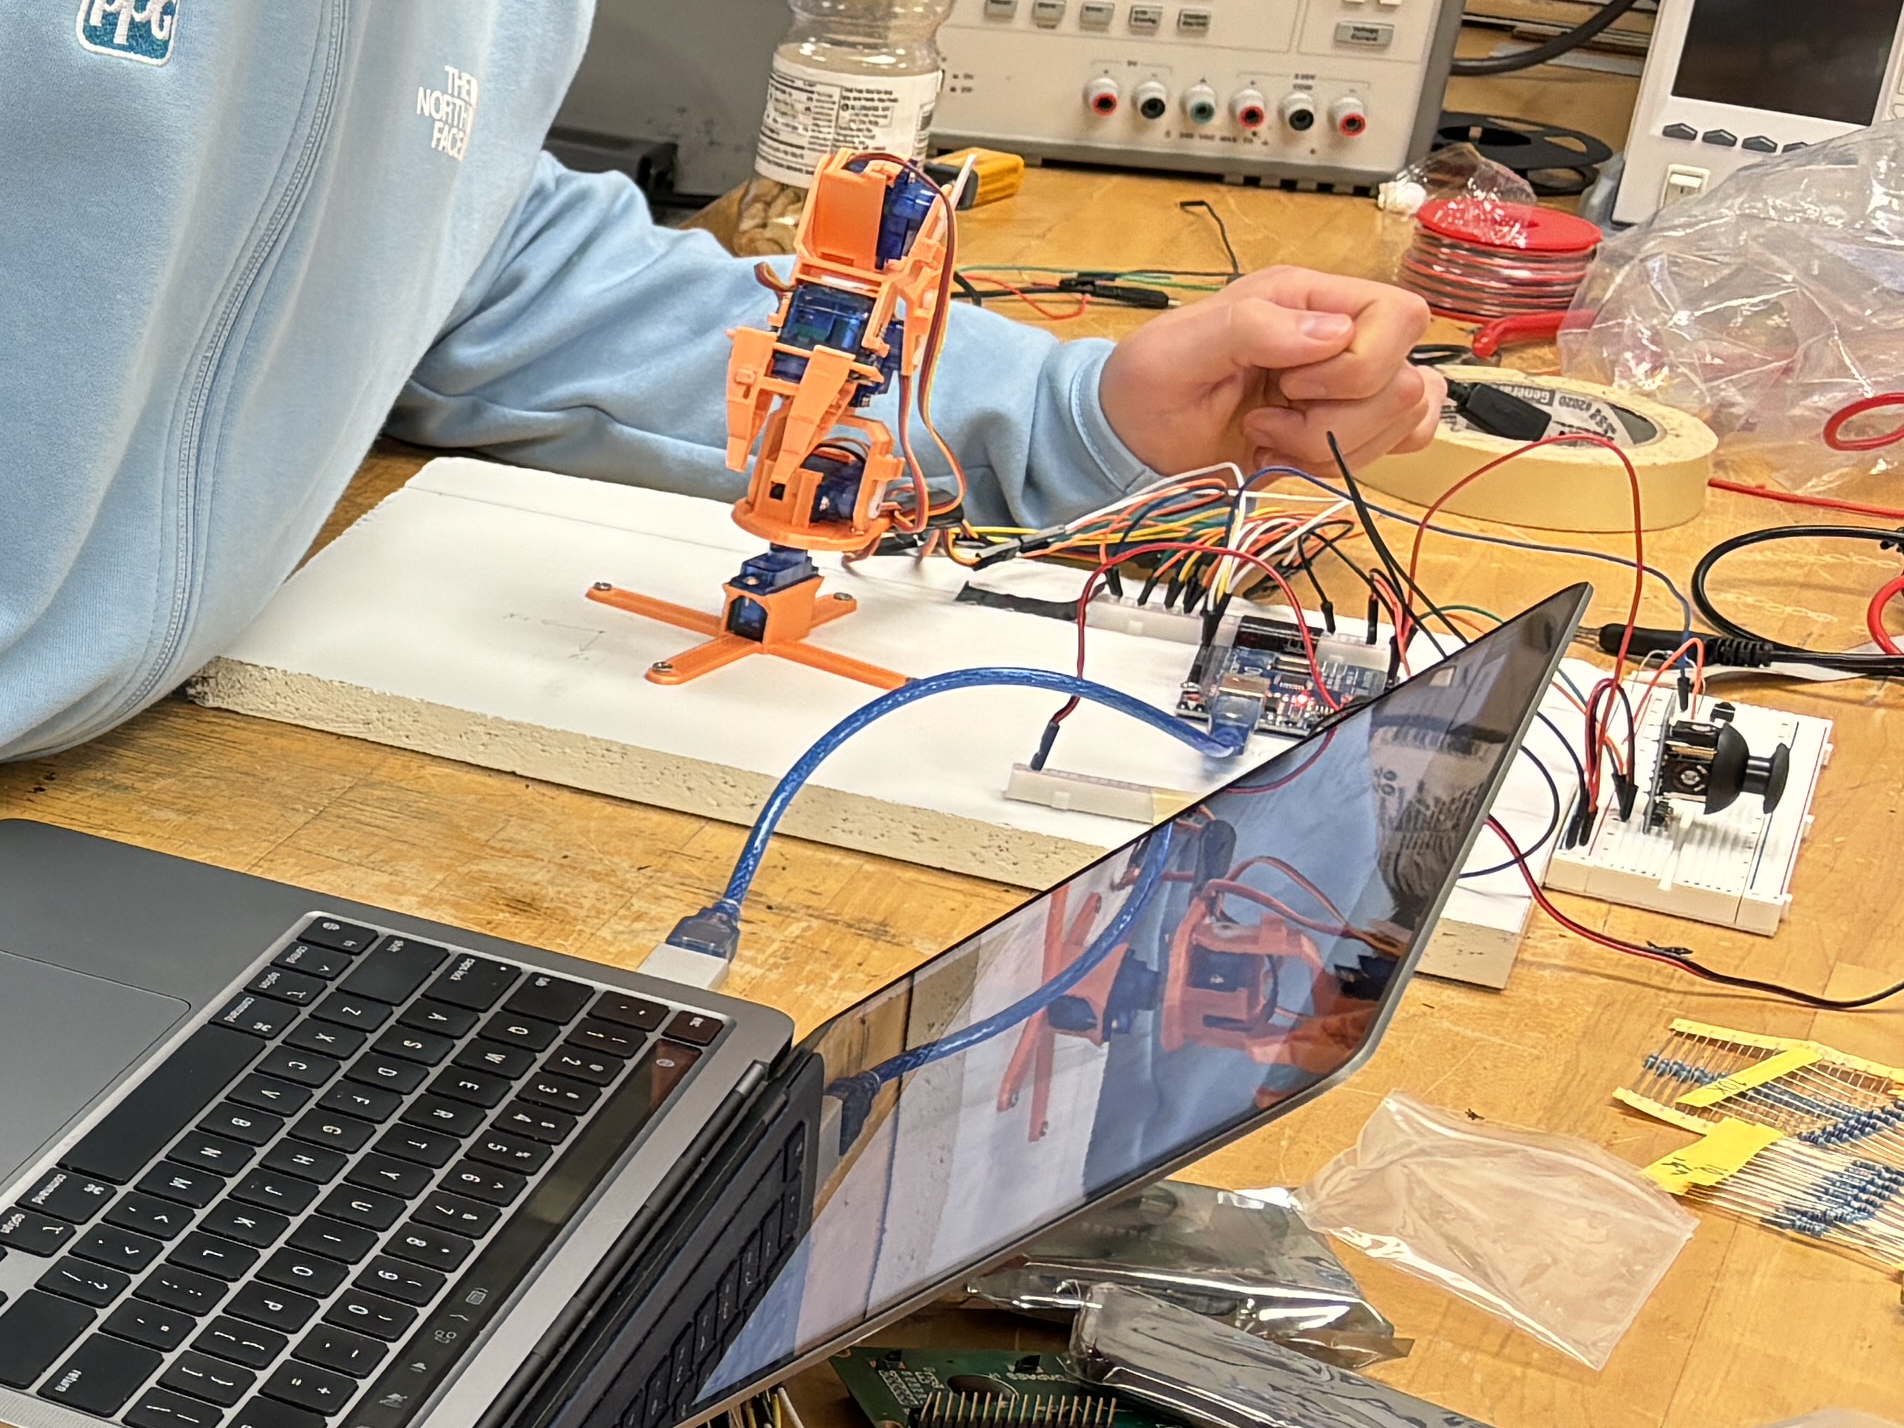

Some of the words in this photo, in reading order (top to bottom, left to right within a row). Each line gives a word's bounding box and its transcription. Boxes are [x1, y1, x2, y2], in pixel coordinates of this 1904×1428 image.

[444, 65, 470, 103] THE
[415, 86, 472, 129] NORTH
[431, 121, 466, 162] FACE
[342, 1006, 362, 1016] Z
[428, 1012, 448, 1021] A
[507, 1026, 529, 1035] Q
[315, 1032, 335, 1043] X
[403, 1040, 423, 1049] S
[484, 1052, 506, 1064] W
[561, 1056, 582, 1066] 2
[288, 1061, 307, 1070] C
[377, 1067, 398, 1077] D
[459, 1081, 479, 1090] E
[538, 1084, 558, 1094] 3
[261, 1090, 281, 1099] V
[352, 1095, 370, 1105] F
[433, 1109, 454, 1119] R
[513, 1113, 532, 1123] 4
[231, 1117, 251, 1127] B
[322, 1125, 342, 1135] G
[407, 1140, 427, 1149] T
[487, 1142, 508, 1152] 5
[200, 1147, 222, 1158] N
[292, 1154, 315, 1165] H
[380, 1170, 400, 1180] Y
[461, 1173, 481, 1183] 6
[169, 1177, 192, 1189] M
[264, 1185, 282, 1196] J
[351, 1201, 373, 1212] U
[435, 1205, 455, 1215] 7
[233, 1216, 256, 1228] K
[323, 1234, 342, 1242] I
[406, 1236, 427, 1247] 8
[202, 1249, 224, 1258] L
[292, 1266, 314, 1277] O
[378, 1270, 398, 1281] 9
[264, 1300, 283, 1311] P
[348, 1304, 369, 1315] 0
